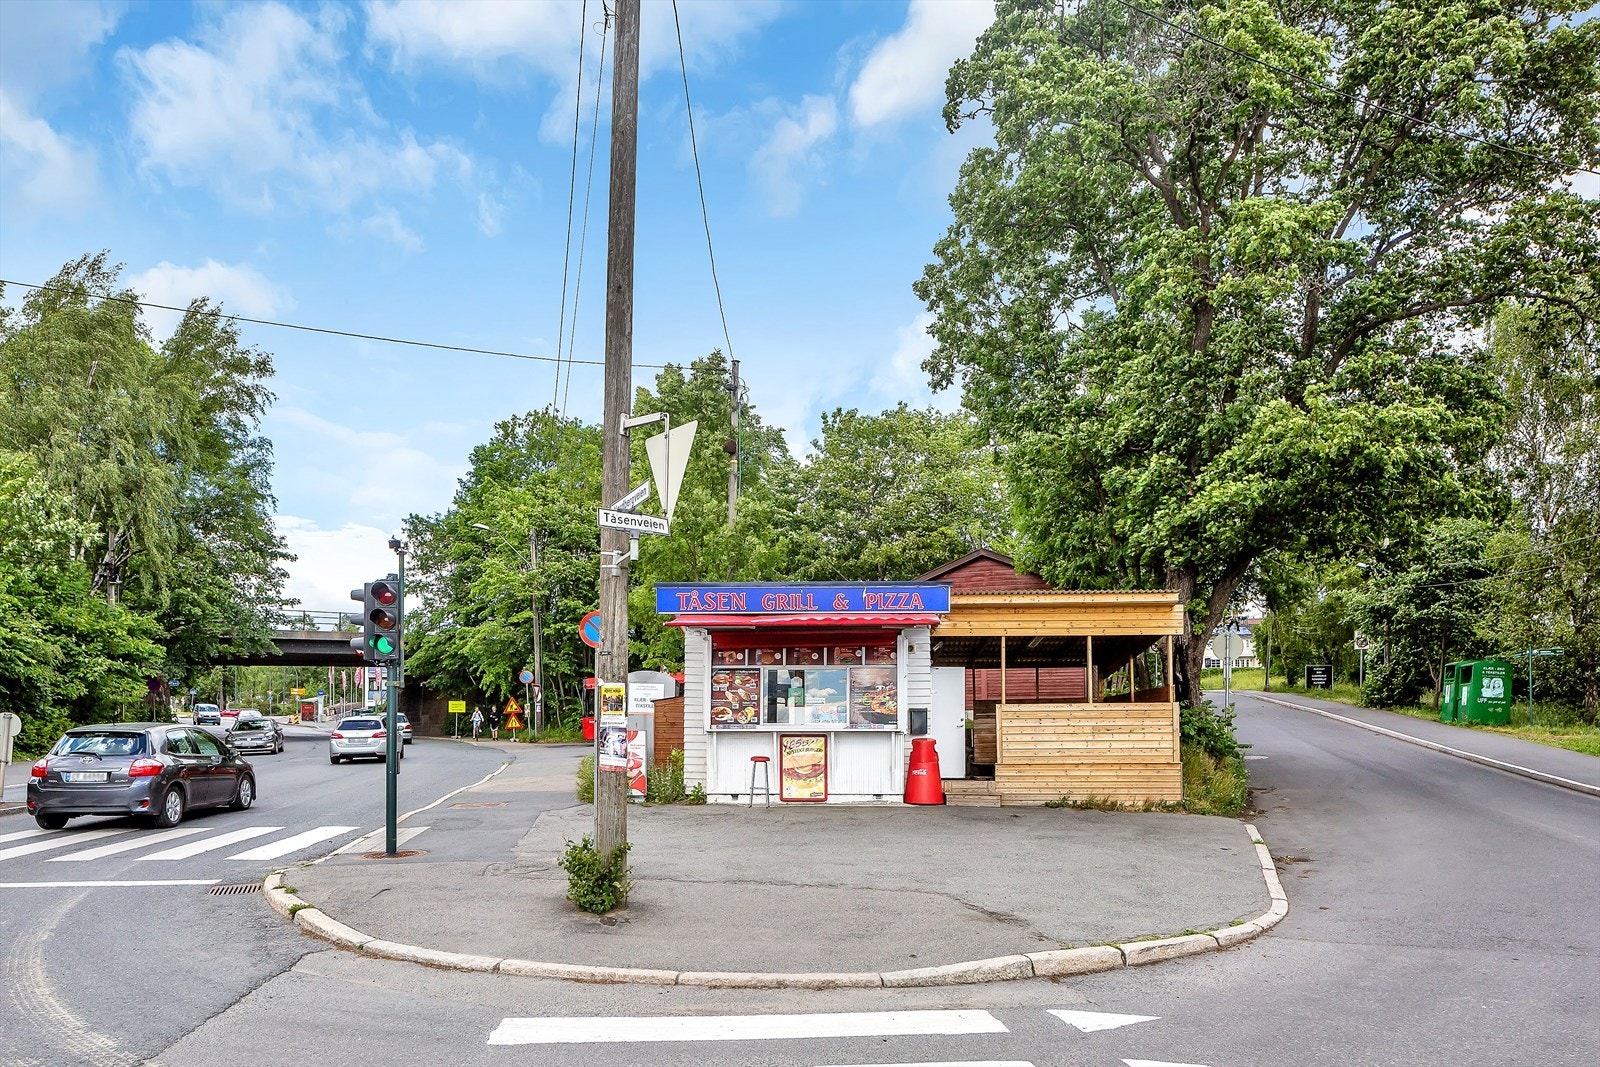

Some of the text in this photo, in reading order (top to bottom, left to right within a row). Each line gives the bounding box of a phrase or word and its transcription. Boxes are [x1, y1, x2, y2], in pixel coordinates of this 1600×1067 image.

[603, 512, 665, 531] Tåsenveien
[675, 590, 924, 611] TÅSEN GRILL & PIZZA
